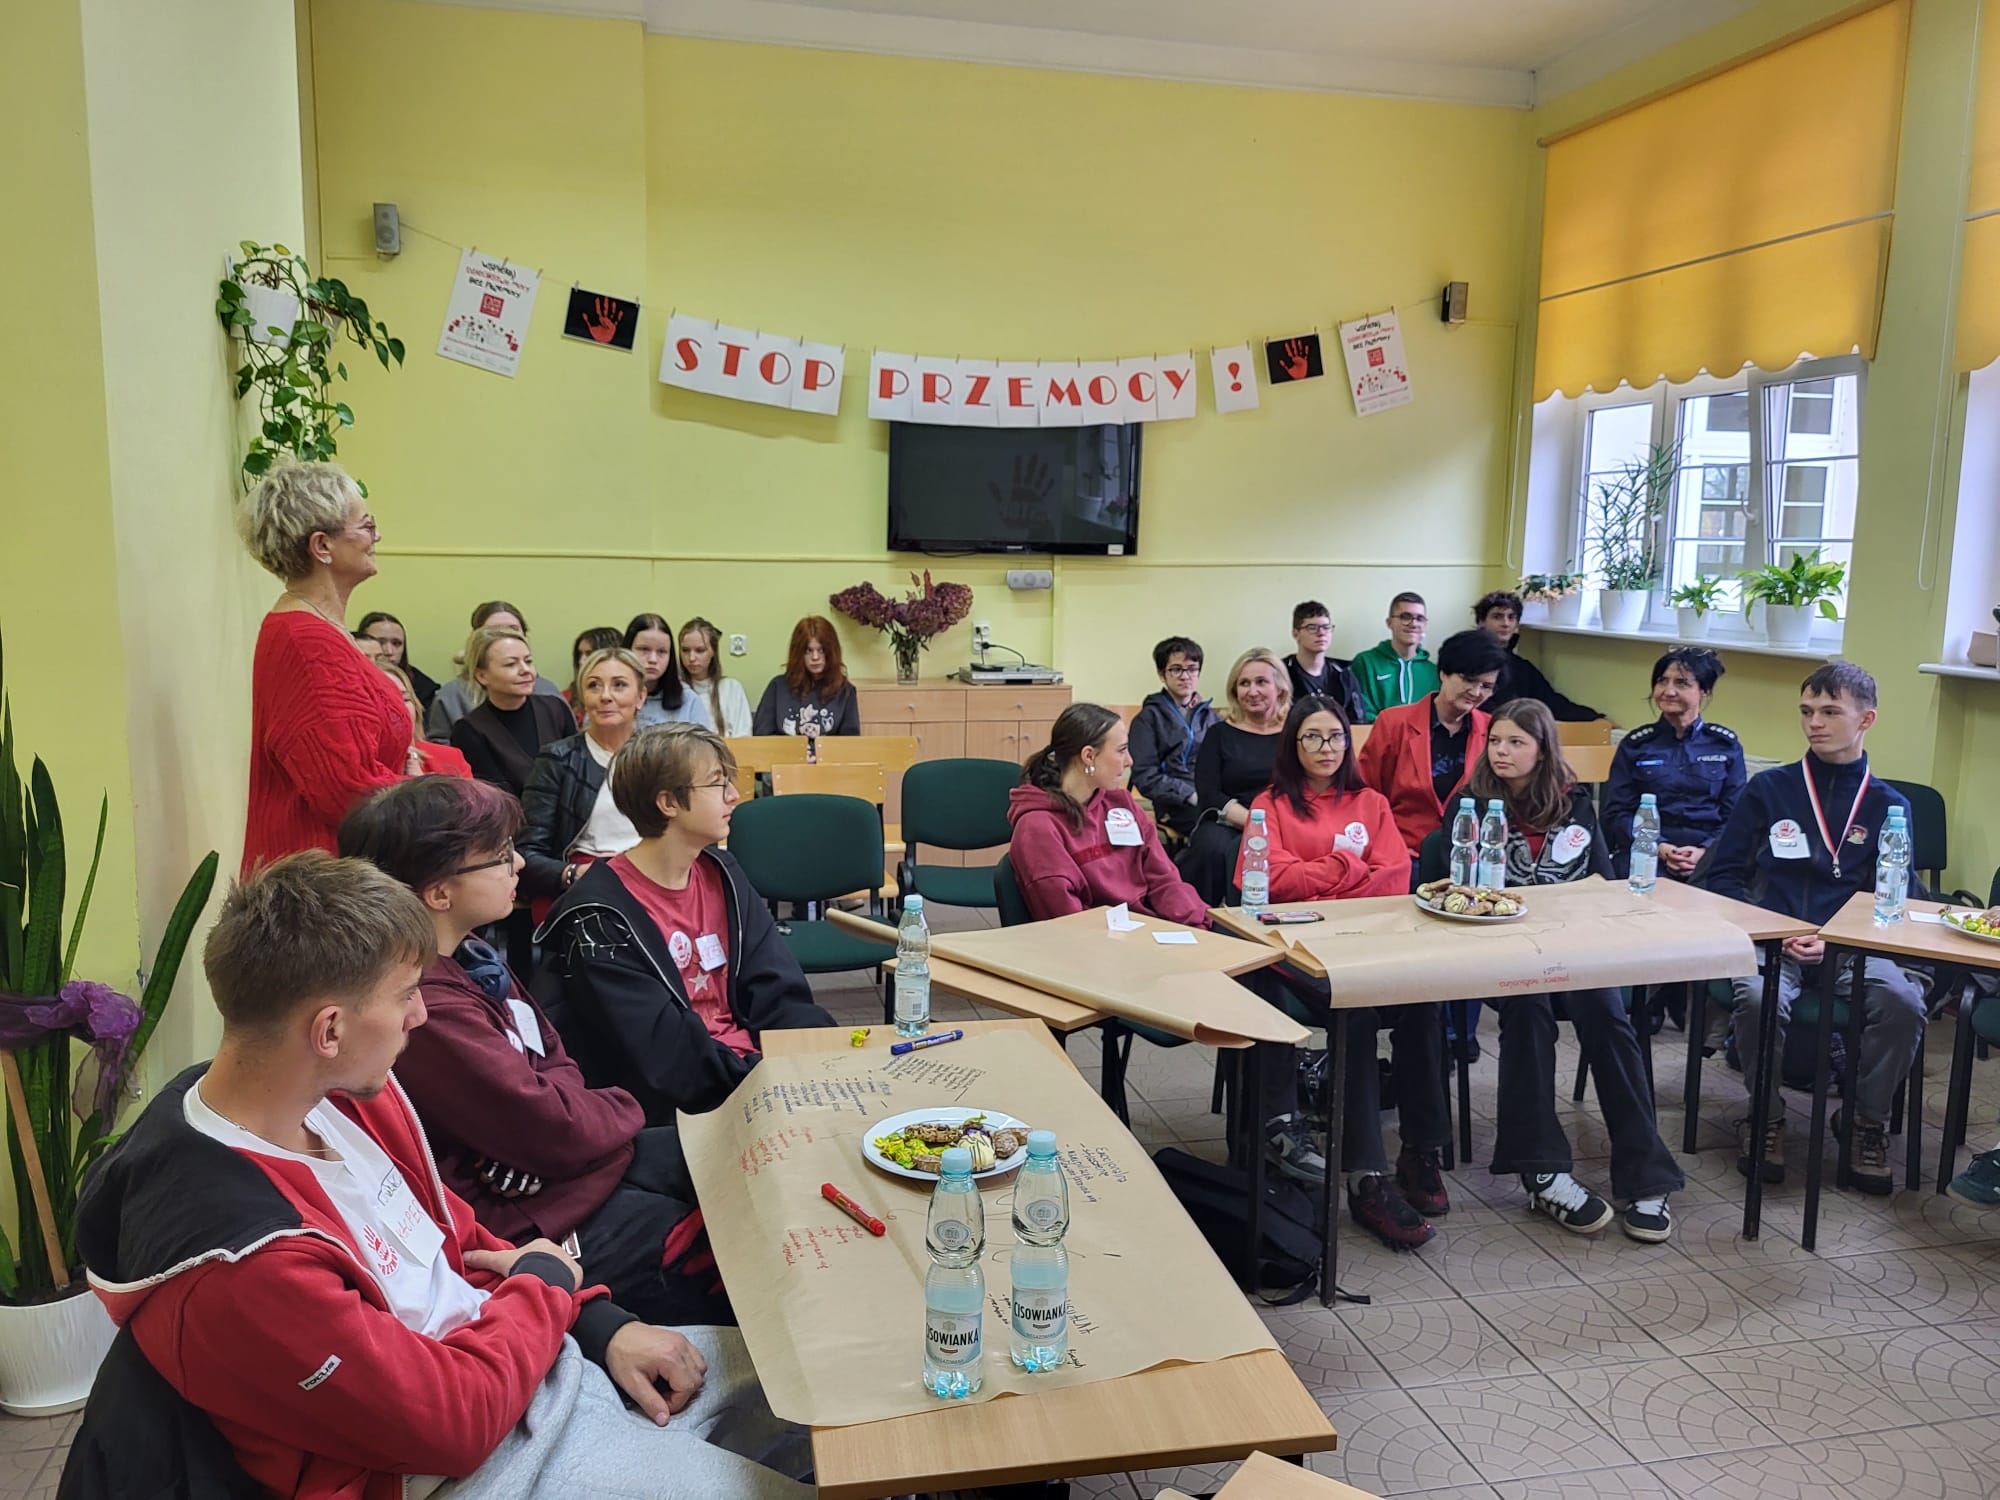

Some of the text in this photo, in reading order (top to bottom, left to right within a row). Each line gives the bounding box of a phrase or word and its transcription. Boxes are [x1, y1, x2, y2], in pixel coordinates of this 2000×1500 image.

[675, 337, 836, 391] STOP
[877, 367, 1191, 408] PRZEMOCY
[304, 1361, 335, 1388] FOCUS
